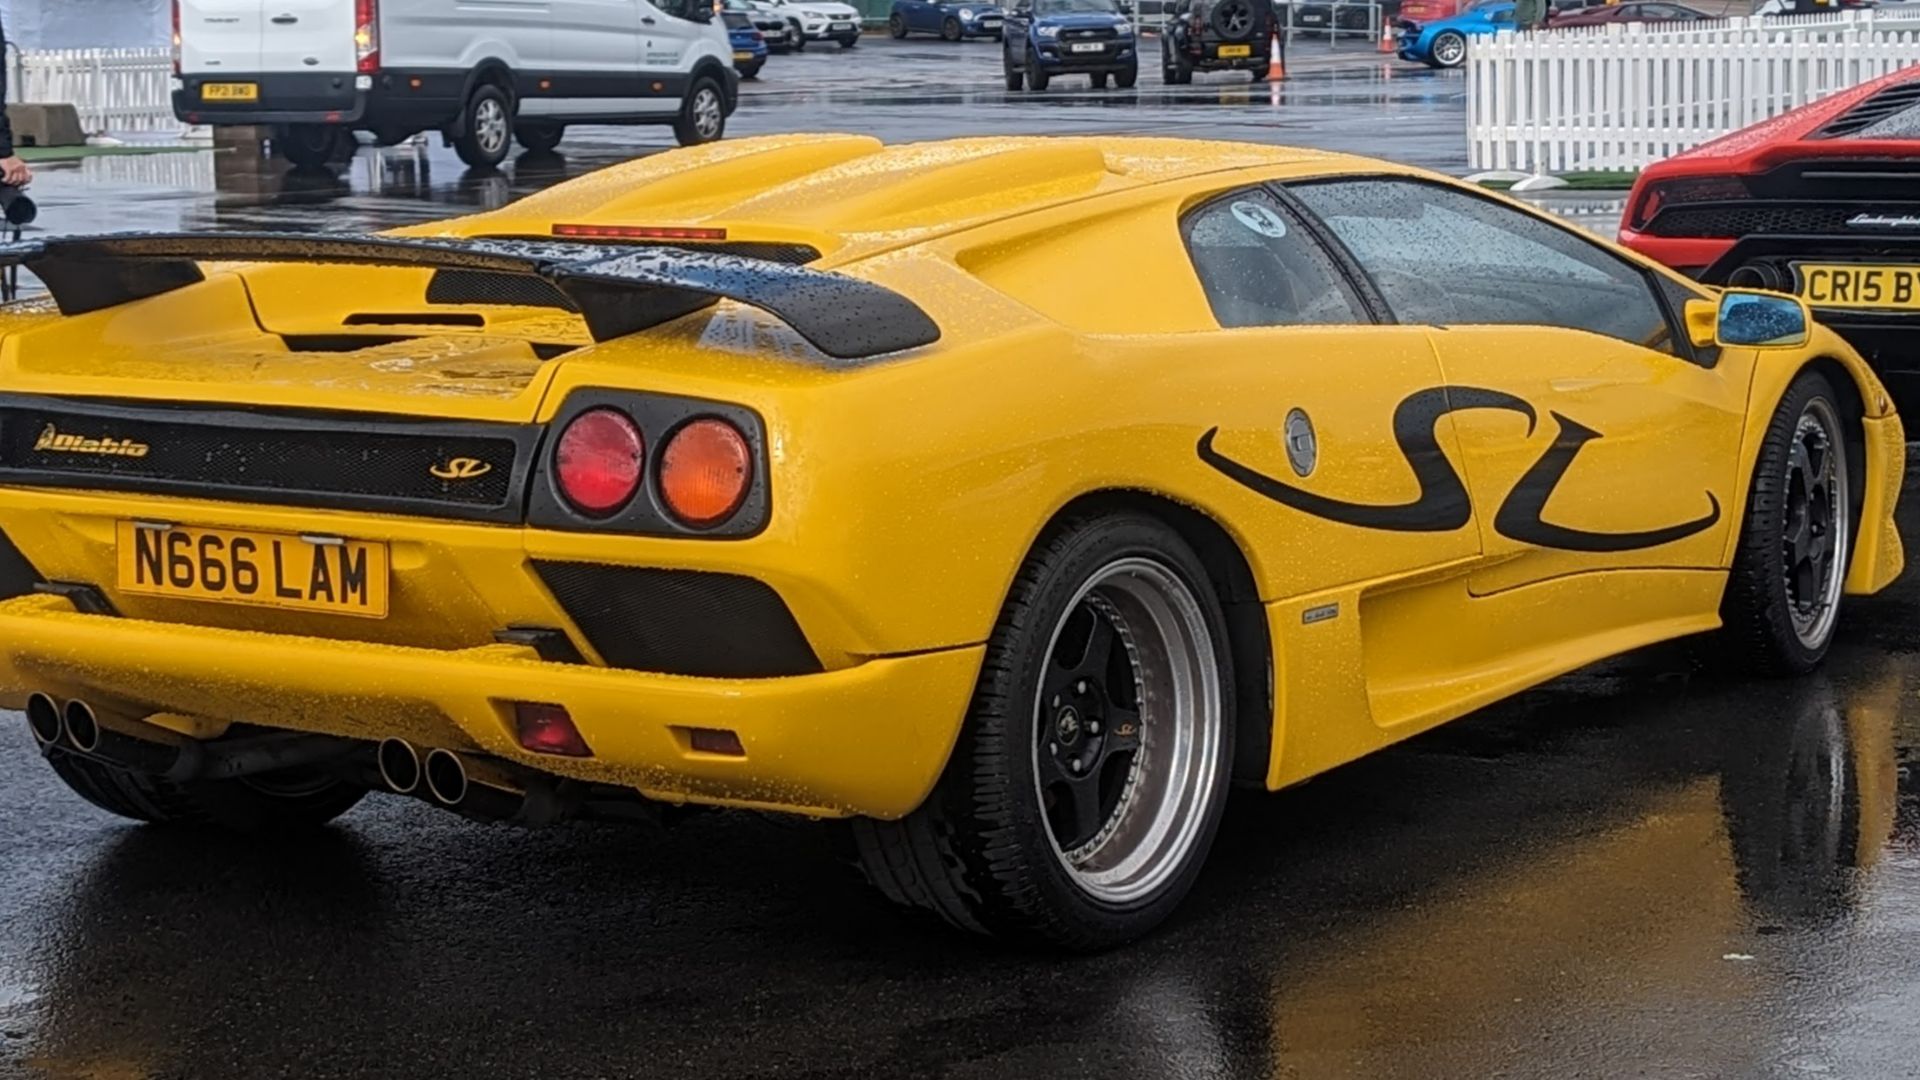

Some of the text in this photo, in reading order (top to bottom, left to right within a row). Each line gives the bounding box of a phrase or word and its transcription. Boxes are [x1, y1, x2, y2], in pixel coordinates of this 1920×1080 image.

[1846, 213, 1920, 227] Lamborghin
[1808, 269, 1883, 302] CR15
[51, 433, 149, 457] Diablo
[134, 527, 368, 606] N666 LAM
